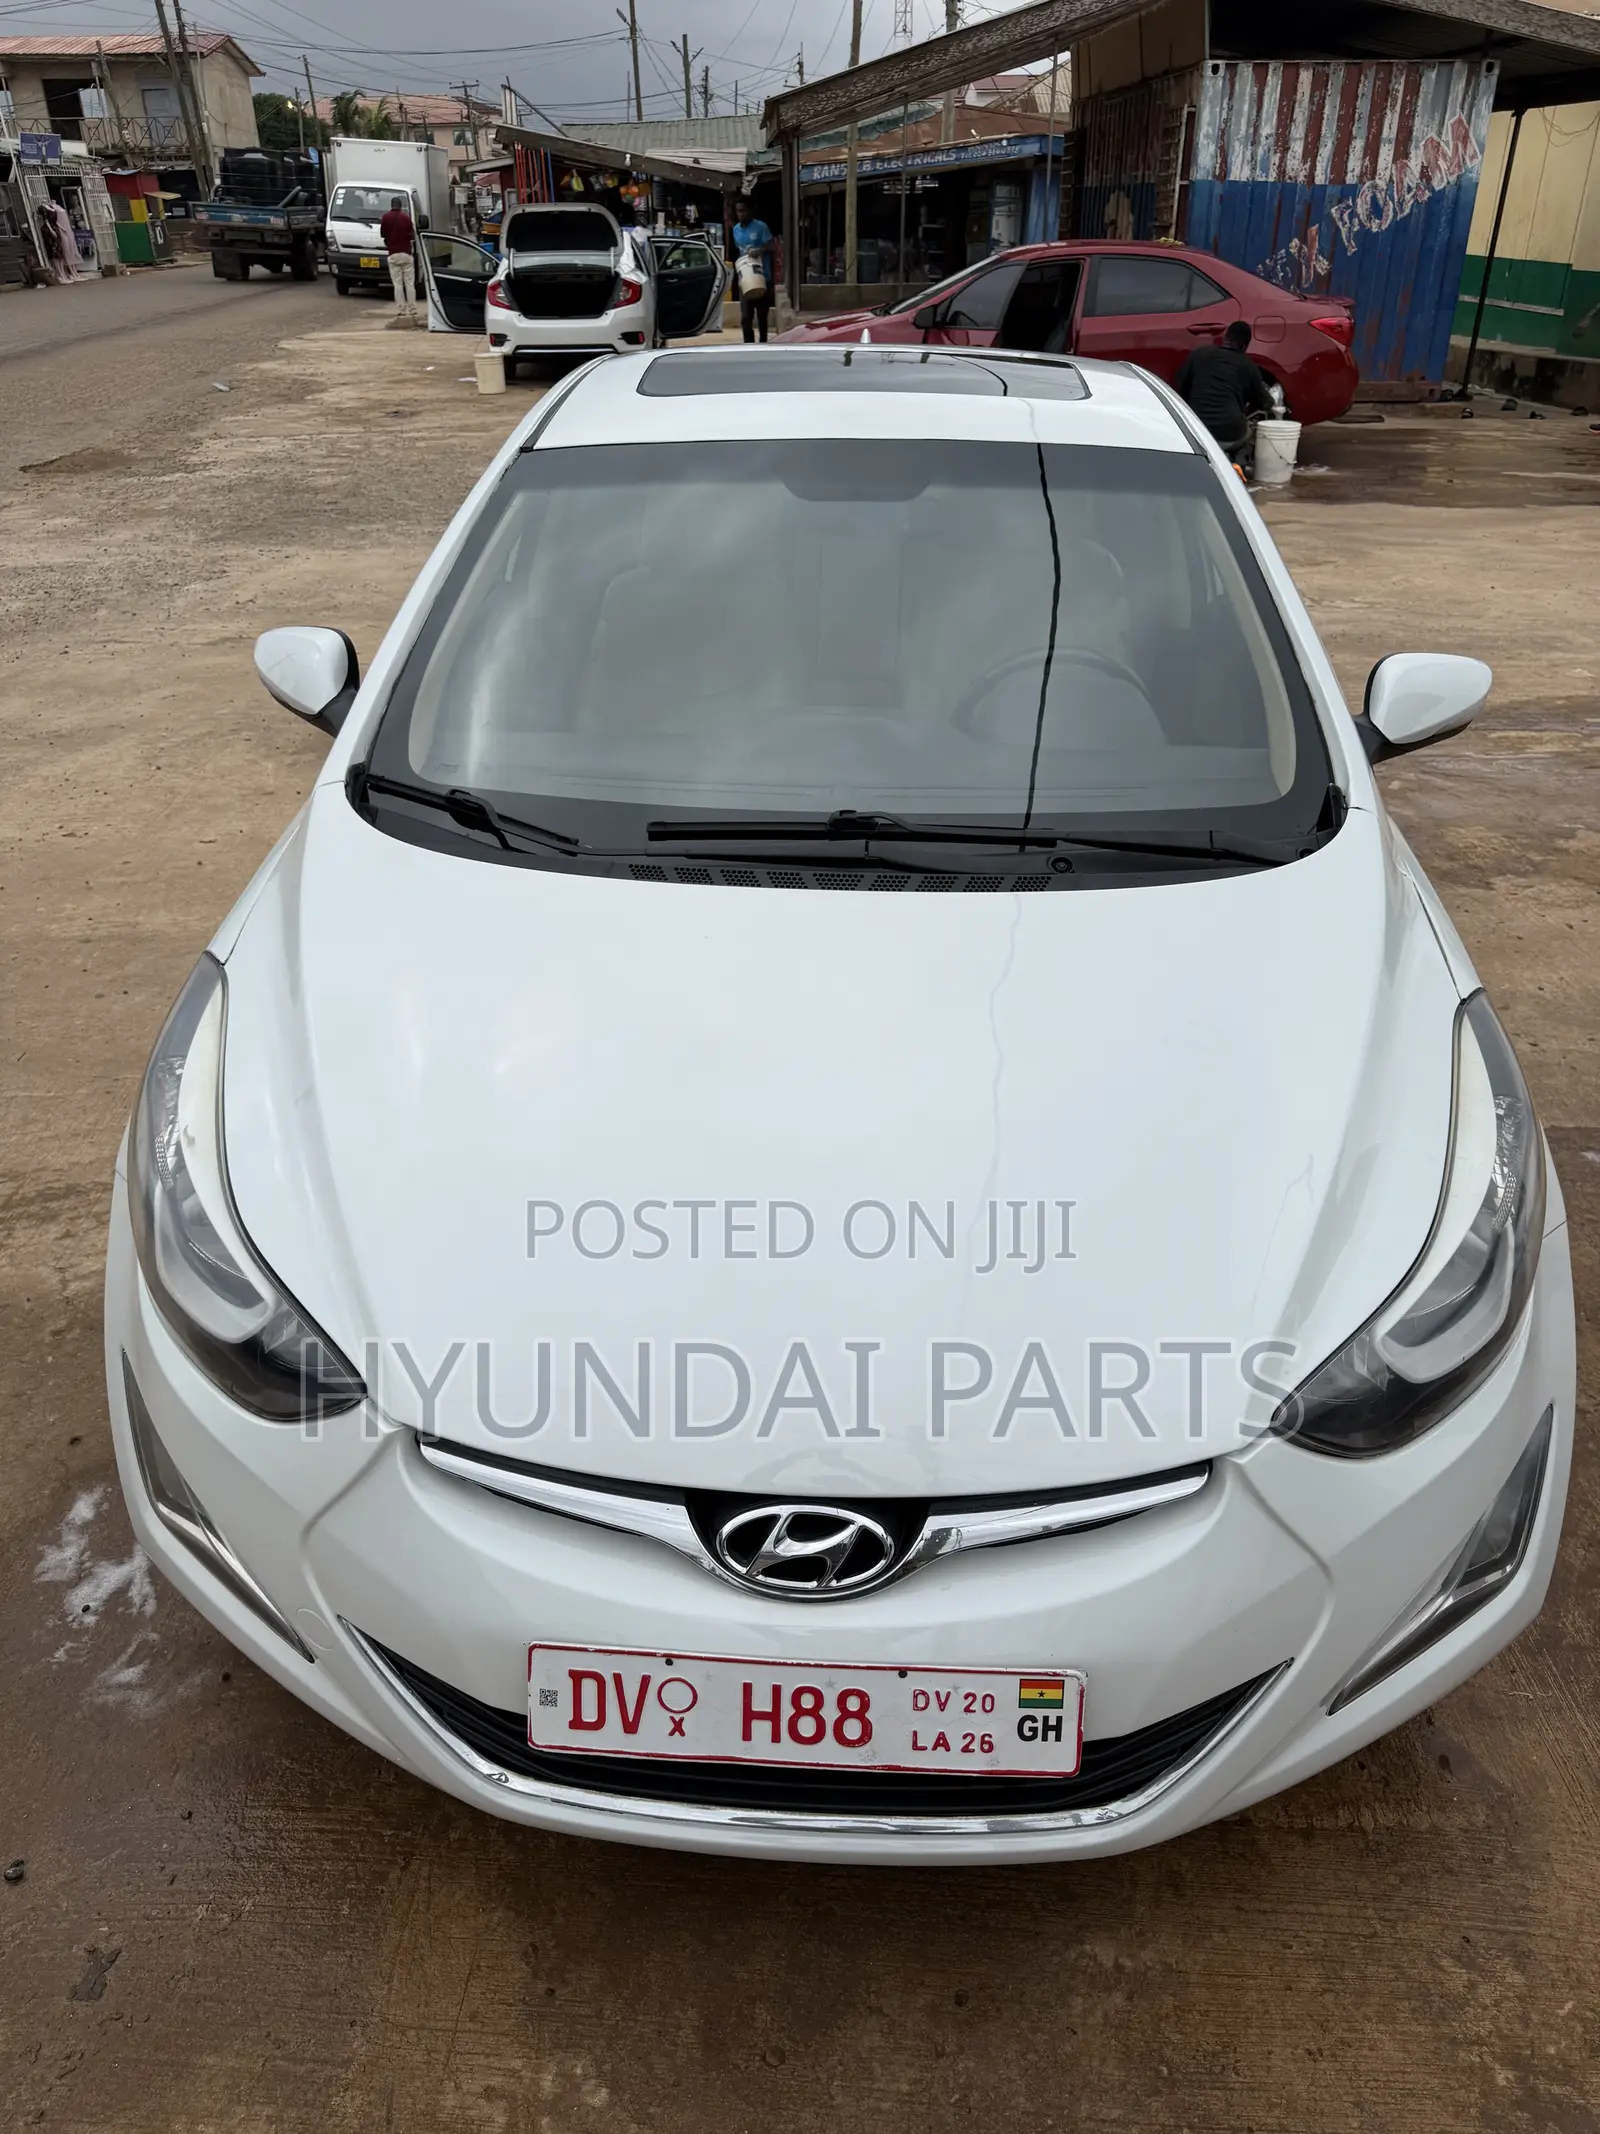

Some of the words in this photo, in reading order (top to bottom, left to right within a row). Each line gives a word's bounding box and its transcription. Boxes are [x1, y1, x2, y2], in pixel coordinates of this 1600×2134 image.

[1331, 112, 1482, 257] FOAM
[568, 1668, 651, 1735] DV
[742, 1681, 874, 1748] H88
[912, 1688, 951, 1713] DV
[963, 1691, 996, 1713] 20
[912, 1730, 951, 1752] LA
[961, 1732, 995, 1754] 26
[1016, 1714, 1063, 1743] GH
